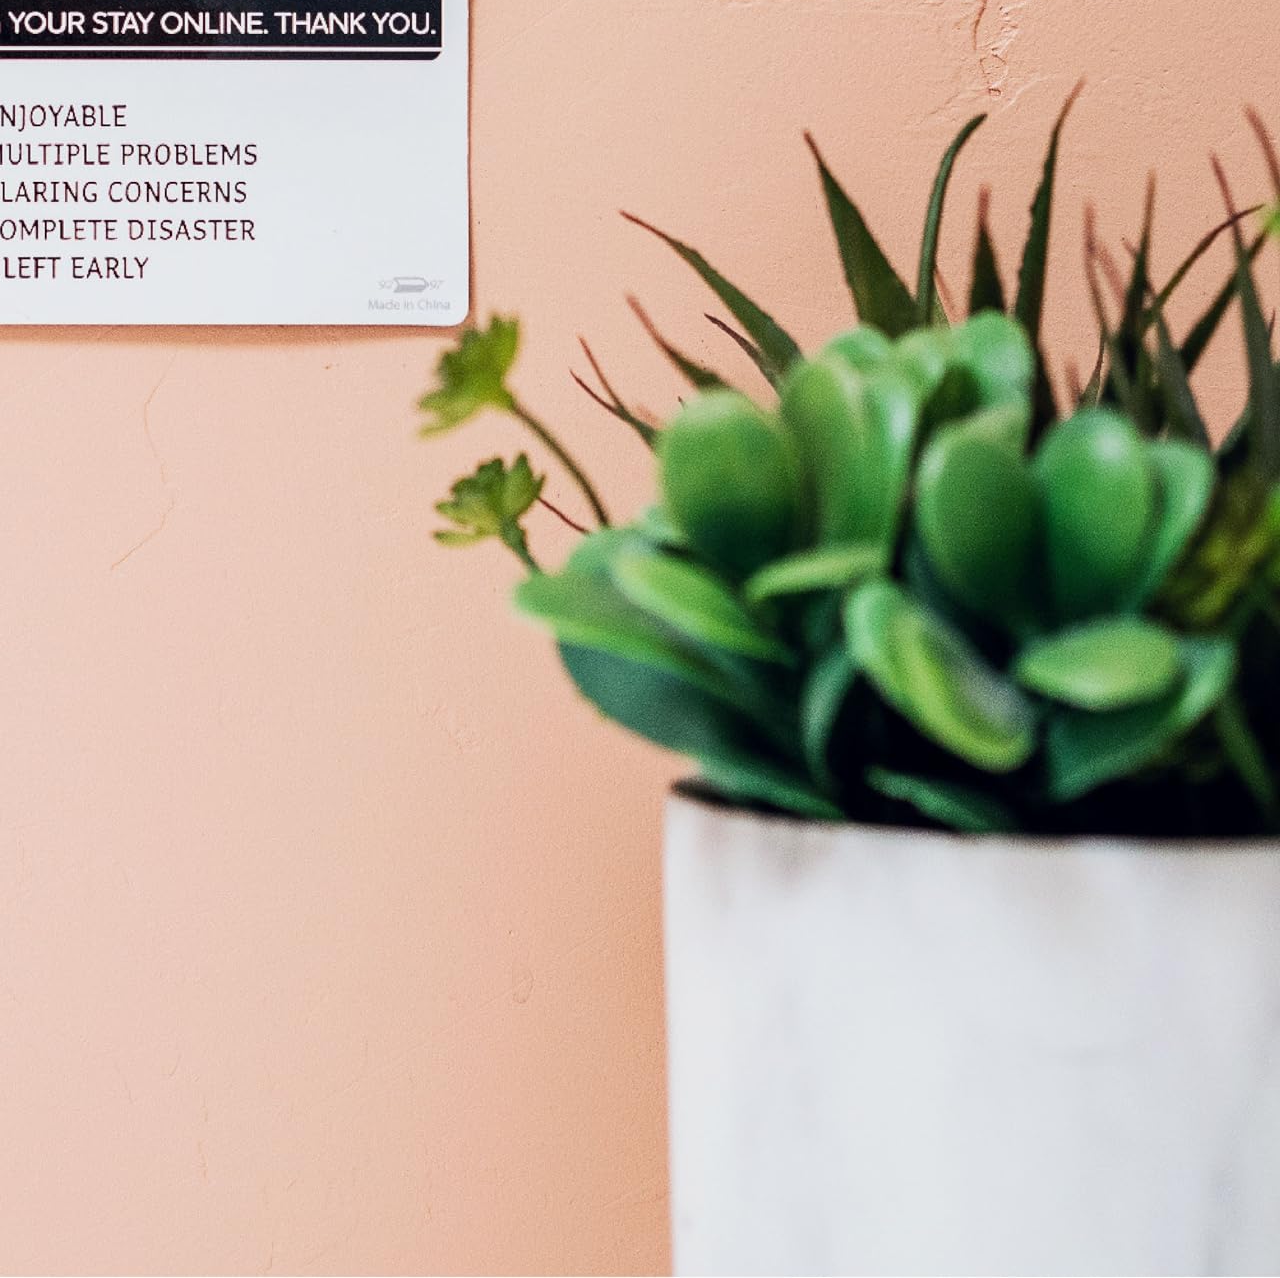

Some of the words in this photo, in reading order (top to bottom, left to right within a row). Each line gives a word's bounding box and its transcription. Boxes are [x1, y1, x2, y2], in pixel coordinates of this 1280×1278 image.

[7, 11, 86, 35] YOUR
[92, 11, 155, 35] STAY
[159, 11, 269, 35] ONLINE.
[273, 11, 367, 35] THANK
[371, 11, 437, 35] YOU.
[120, 143, 258, 166] PROBLEMS
[108, 181, 247, 204] CONCERNS
[127, 219, 256, 241] DISASTER
[2, 256, 62, 279] LEFT
[70, 256, 149, 280] EARLY
[367, 298, 401, 311] Made
[417, 298, 451, 311] China
